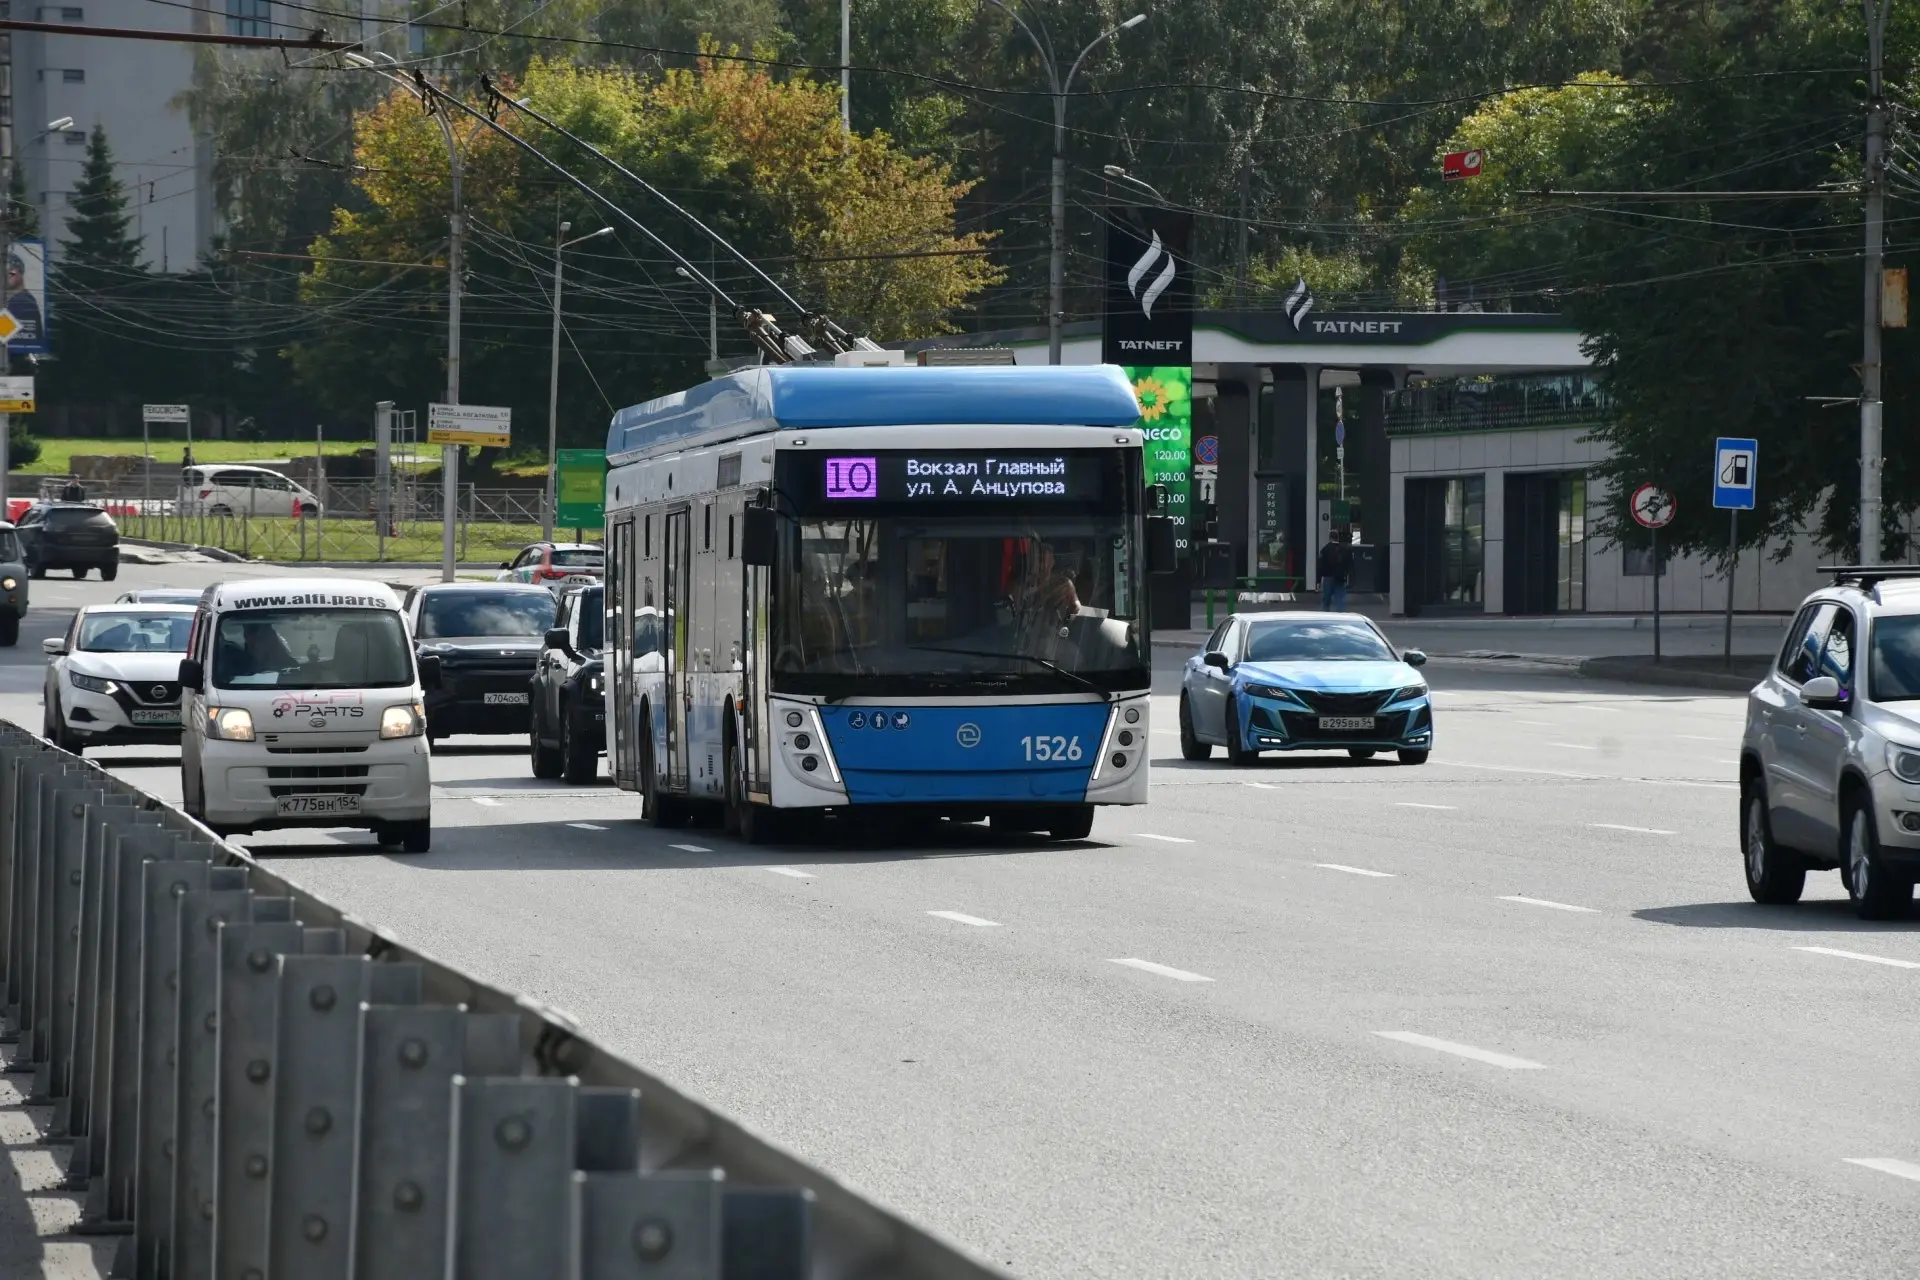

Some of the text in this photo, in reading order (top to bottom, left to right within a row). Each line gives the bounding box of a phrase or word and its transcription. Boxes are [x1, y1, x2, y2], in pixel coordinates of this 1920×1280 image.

[1312, 321, 1402, 333] TATNEFT
[1118, 340, 1183, 350] TATNEFT
[1154, 450, 1186, 460] 120.00
[907, 457, 1065, 476] Вокзал Главный
[828, 462, 872, 493] 10
[1154, 472, 1186, 482] 130.00
[907, 478, 1065, 497] ул. А. Анцупова
[233, 593, 387, 609] www.alfi.parts
[272, 691, 363, 706] ALFI
[295, 705, 364, 717] PARTS
[1021, 735, 1082, 761] 1526
[282, 796, 358, 812] К775ВН 154
